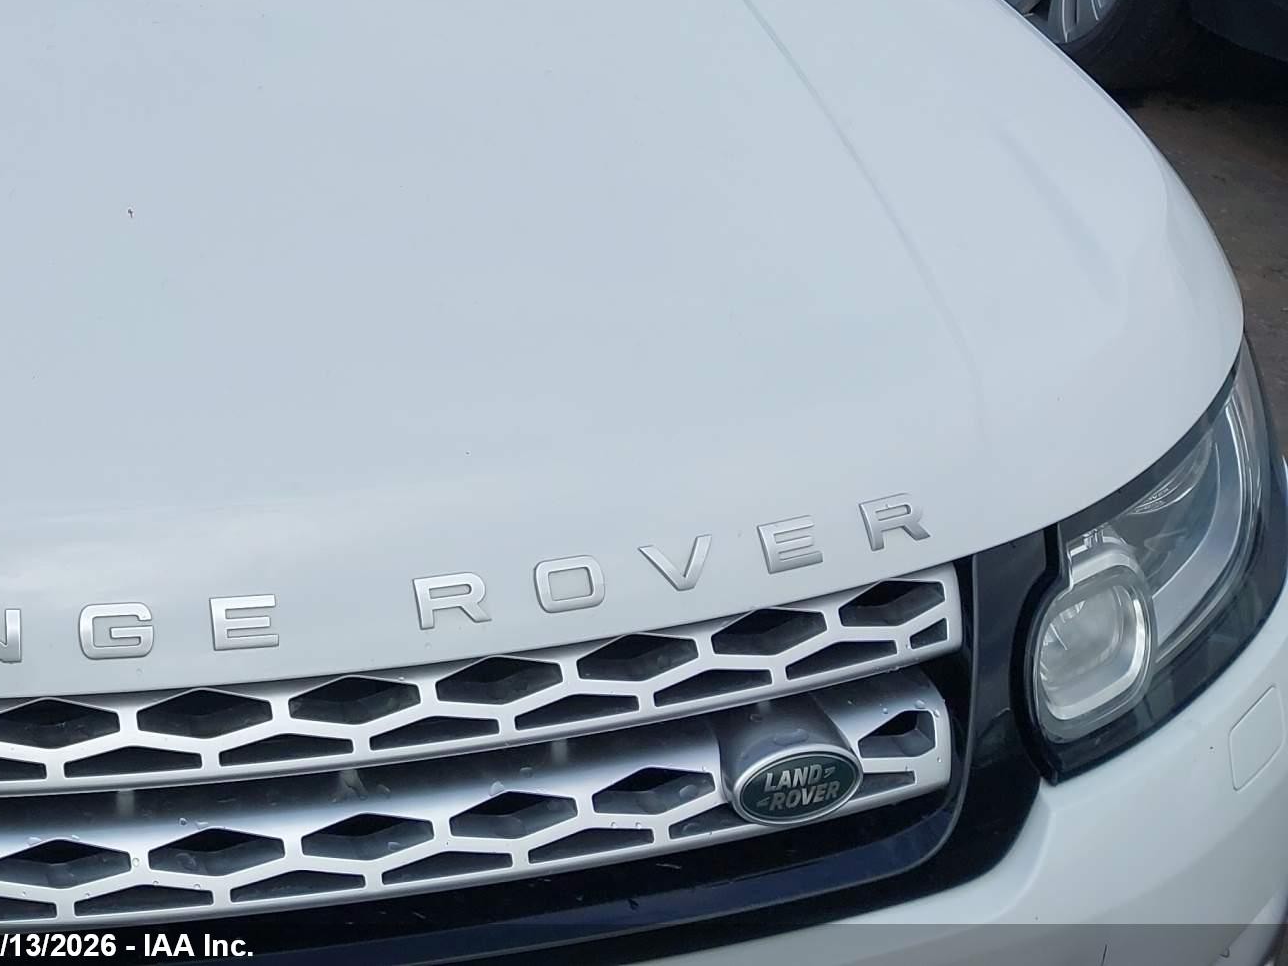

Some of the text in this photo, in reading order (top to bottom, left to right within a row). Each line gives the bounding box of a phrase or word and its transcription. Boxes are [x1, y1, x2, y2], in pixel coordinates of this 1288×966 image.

[414, 492, 932, 631] ROVER
[764, 764, 822, 792] LAND
[769, 781, 840, 811] ROVER
